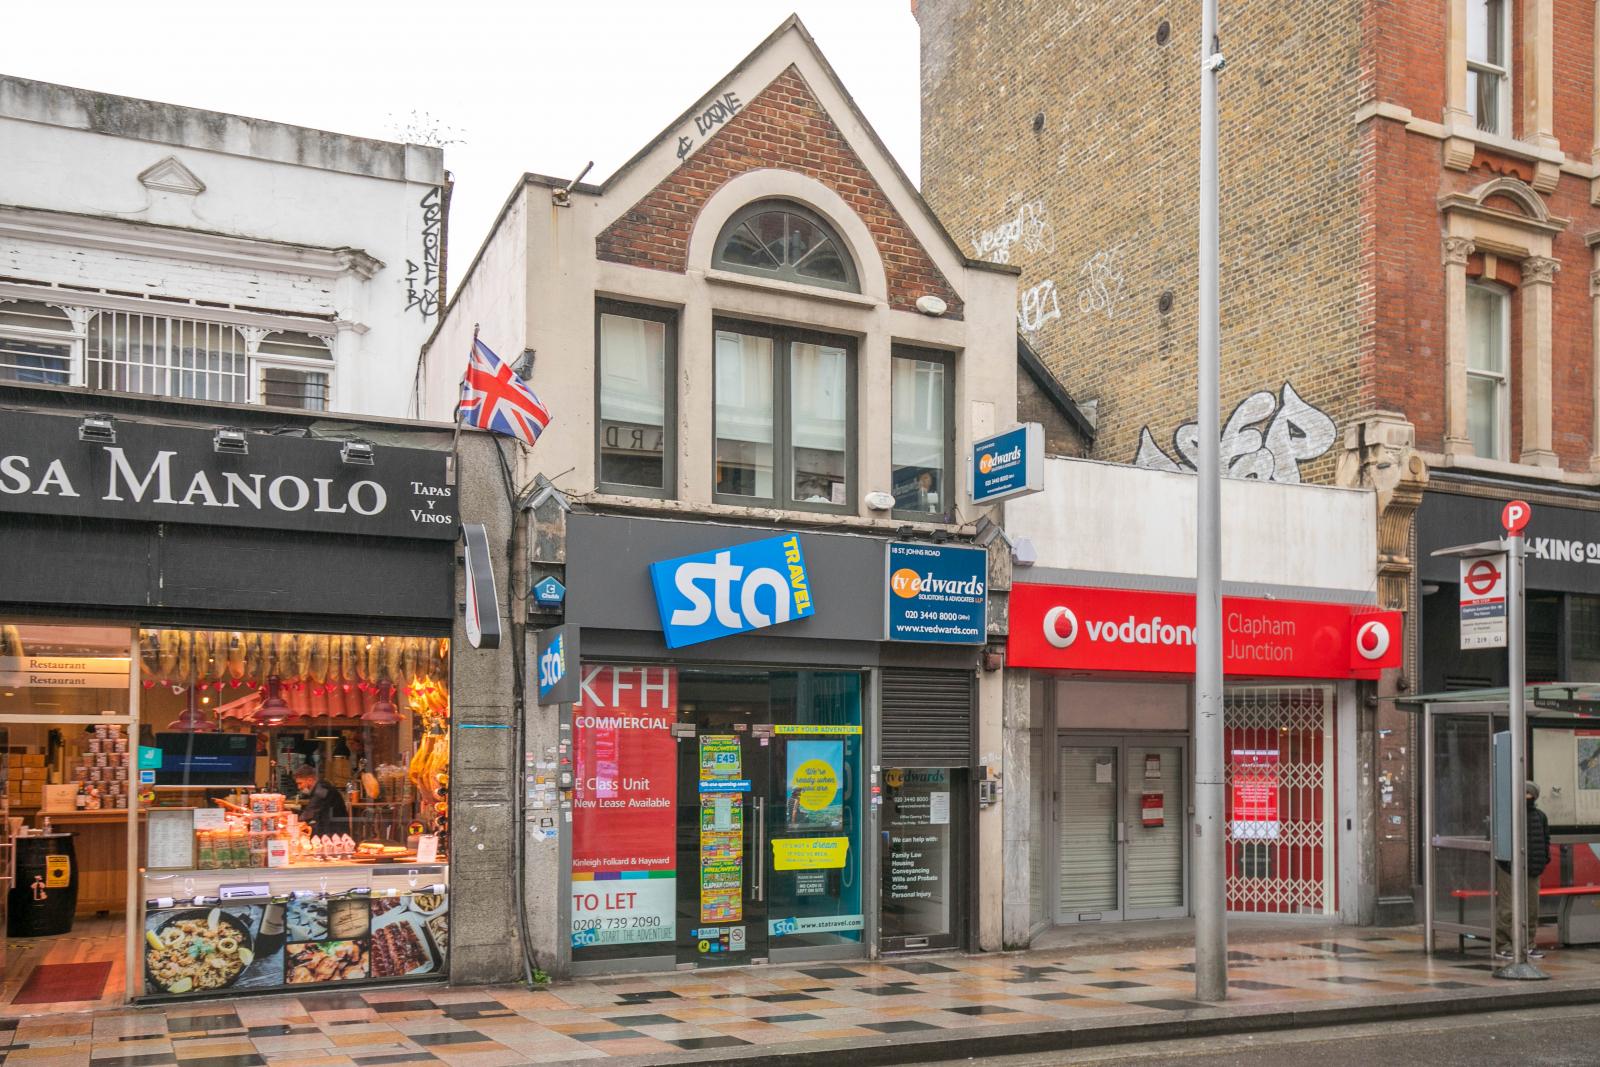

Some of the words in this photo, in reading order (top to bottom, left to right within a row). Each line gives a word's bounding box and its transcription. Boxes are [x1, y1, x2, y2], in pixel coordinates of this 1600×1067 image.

[102, 446, 387, 516] MANOLO
[410, 481, 452, 497] TAPAS
[426, 500, 436, 510] Y
[410, 509, 452, 524] VINOS
[1508, 505, 1523, 528] P
[906, 548, 924, 556] JOHNS
[1535, 536, 1585, 563] KING
[1586, 542, 1600, 559] O
[670, 550, 790, 629] sta
[783, 536, 811, 615] TRAVEL
[893, 573, 909, 590] tv
[910, 572, 984, 596] edwards
[904, 610, 918, 619] 020
[920, 611, 938, 620] 3440
[939, 612, 957, 621] 8000
[896, 624, 979, 635] www.tvedwards.com
[1228, 613, 1296, 638] Clapham
[1228, 640, 1294, 661] Junction
[29, 659, 86, 670] Restaurant
[541, 647, 561, 687] sta
[29, 675, 86, 686] Restaurant
[575, 665, 670, 709] KFH
[575, 716, 669, 730] COMMERCIAL
[575, 778, 583, 790] E
[586, 778, 618, 790] Class
[623, 777, 650, 790] Unit
[575, 799, 596, 808] New
[600, 798, 626, 808] Lease
[628, 797, 671, 808] Available
[573, 858, 601, 868] Kinleigh
[603, 857, 629, 866] Folkard
[631, 857, 637, 865] &
[638, 855, 670, 866] Hayward
[892, 852, 910, 860] Family
[892, 859, 915, 868] Housing
[892, 867, 930, 875] Conveyancing
[917, 874, 938, 882] Probate
[573, 893, 599, 911] TO
[605, 892, 637, 910] LET
[916, 891, 931, 899] Injury
[573, 918, 602, 931] 0208
[606, 917, 628, 929] 739
[632, 916, 661, 928] 2090
[774, 920, 795, 935] sta
[801, 919, 861, 929] www.statravel.com
[573, 927, 596, 945] sta
[601, 930, 621, 943] START
[623, 930, 634, 942] THE
[637, 927, 673, 942] ADVENTURE
